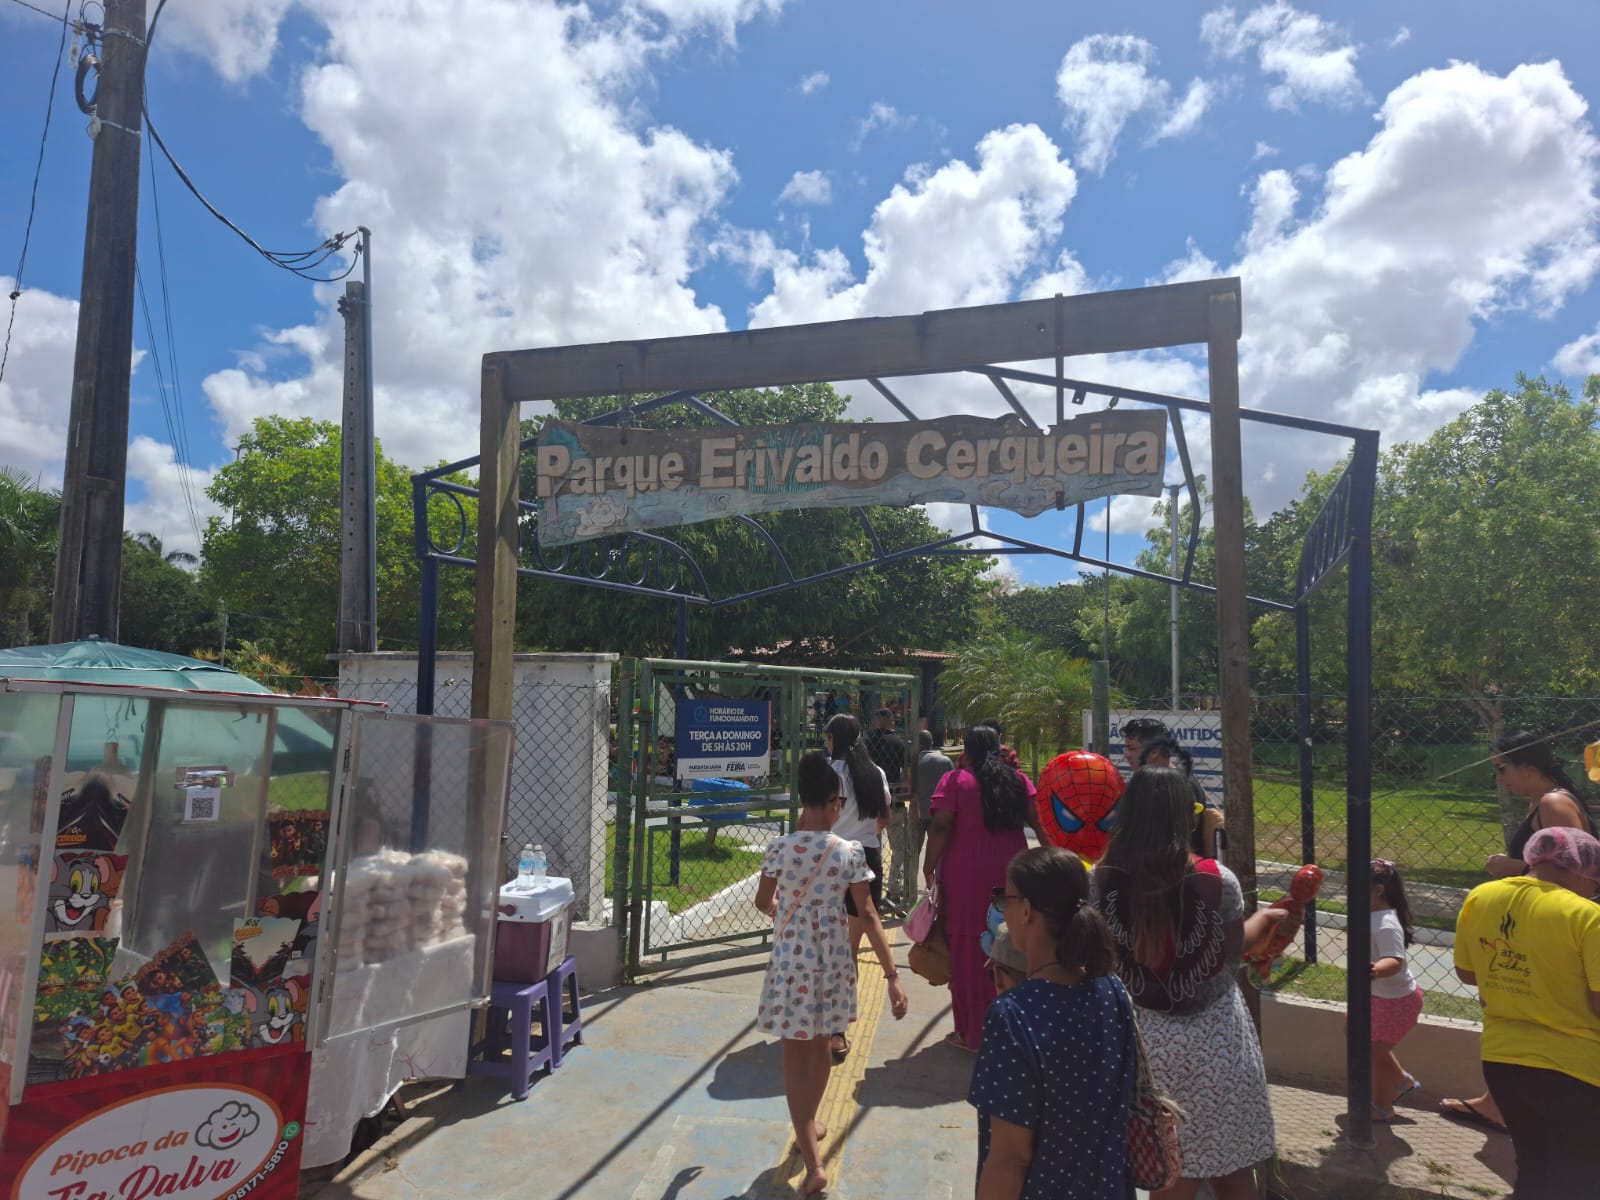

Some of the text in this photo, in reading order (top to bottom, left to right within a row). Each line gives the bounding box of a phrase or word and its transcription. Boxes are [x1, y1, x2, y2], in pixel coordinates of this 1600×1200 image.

[537, 423, 1160, 499] Parque Erivaldo Cerqueira
[709, 706, 736, 715] HORÁRIO
[689, 731, 762, 742] TERÇA A DOMINGO
[1168, 727, 1222, 740] MITIDO
[702, 743, 713, 752] DE
[725, 740, 736, 751] ÀS
[736, 743, 752, 751] 20H
[726, 763, 746, 772] FEIRA
[50, 1130, 190, 1177] Pipoca da
[118, 1155, 242, 1197] Dalva
